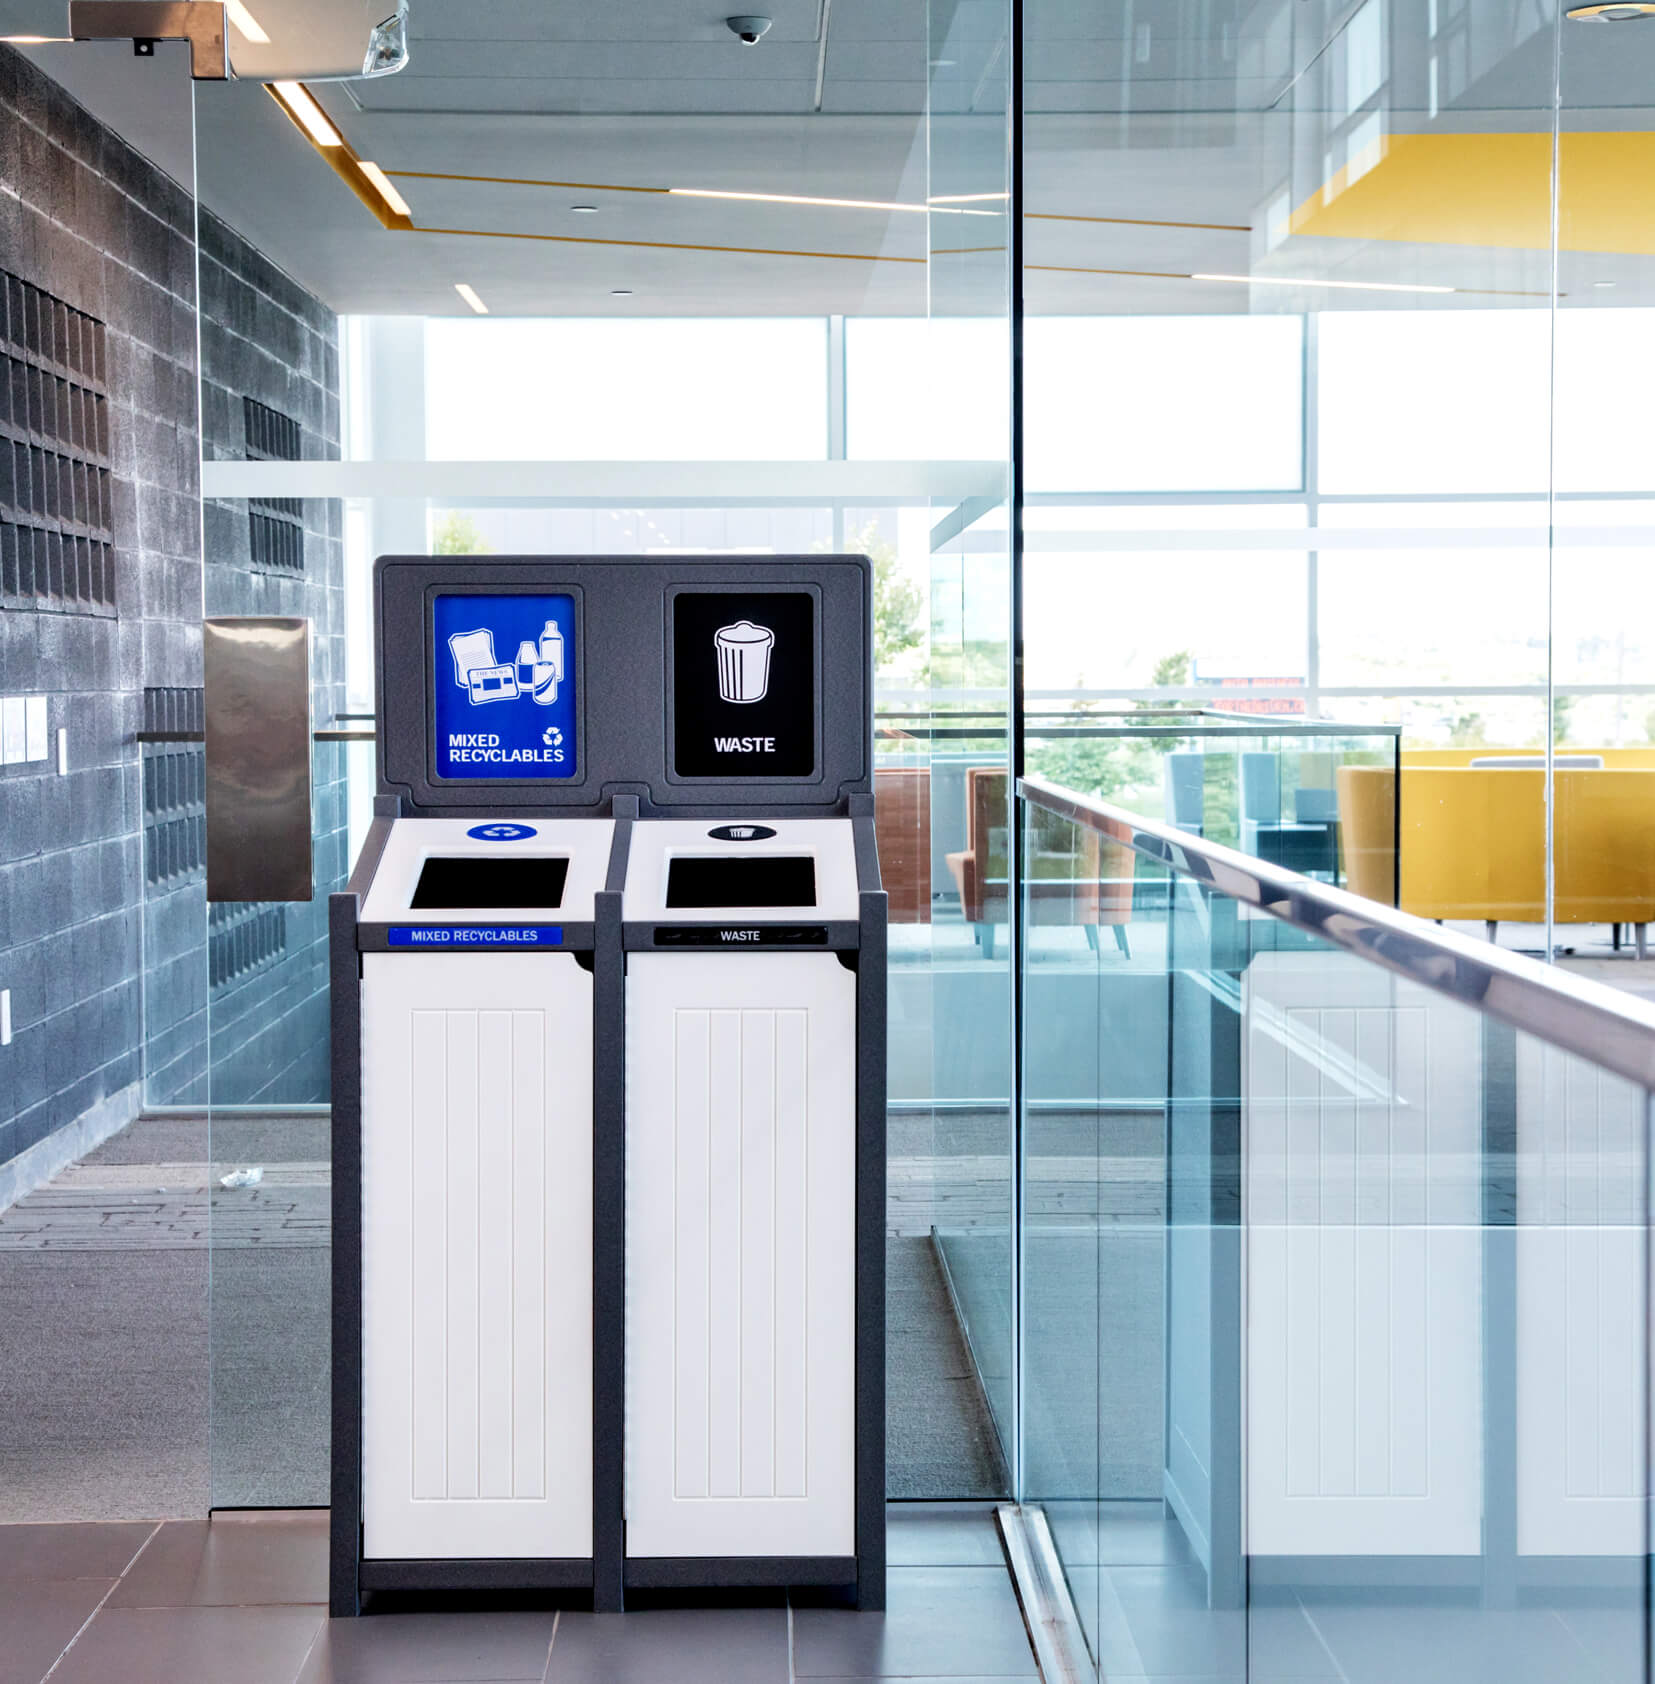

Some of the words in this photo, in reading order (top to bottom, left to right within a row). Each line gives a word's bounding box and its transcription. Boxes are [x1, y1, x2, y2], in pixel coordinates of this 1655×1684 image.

[449, 734, 499, 747] MIXED
[714, 737, 776, 752] WASTE
[450, 749, 564, 762] RECYCLABLES
[411, 930, 450, 942] MIXED
[453, 930, 538, 942] RECYCLABLES
[720, 930, 760, 941] WASTE
